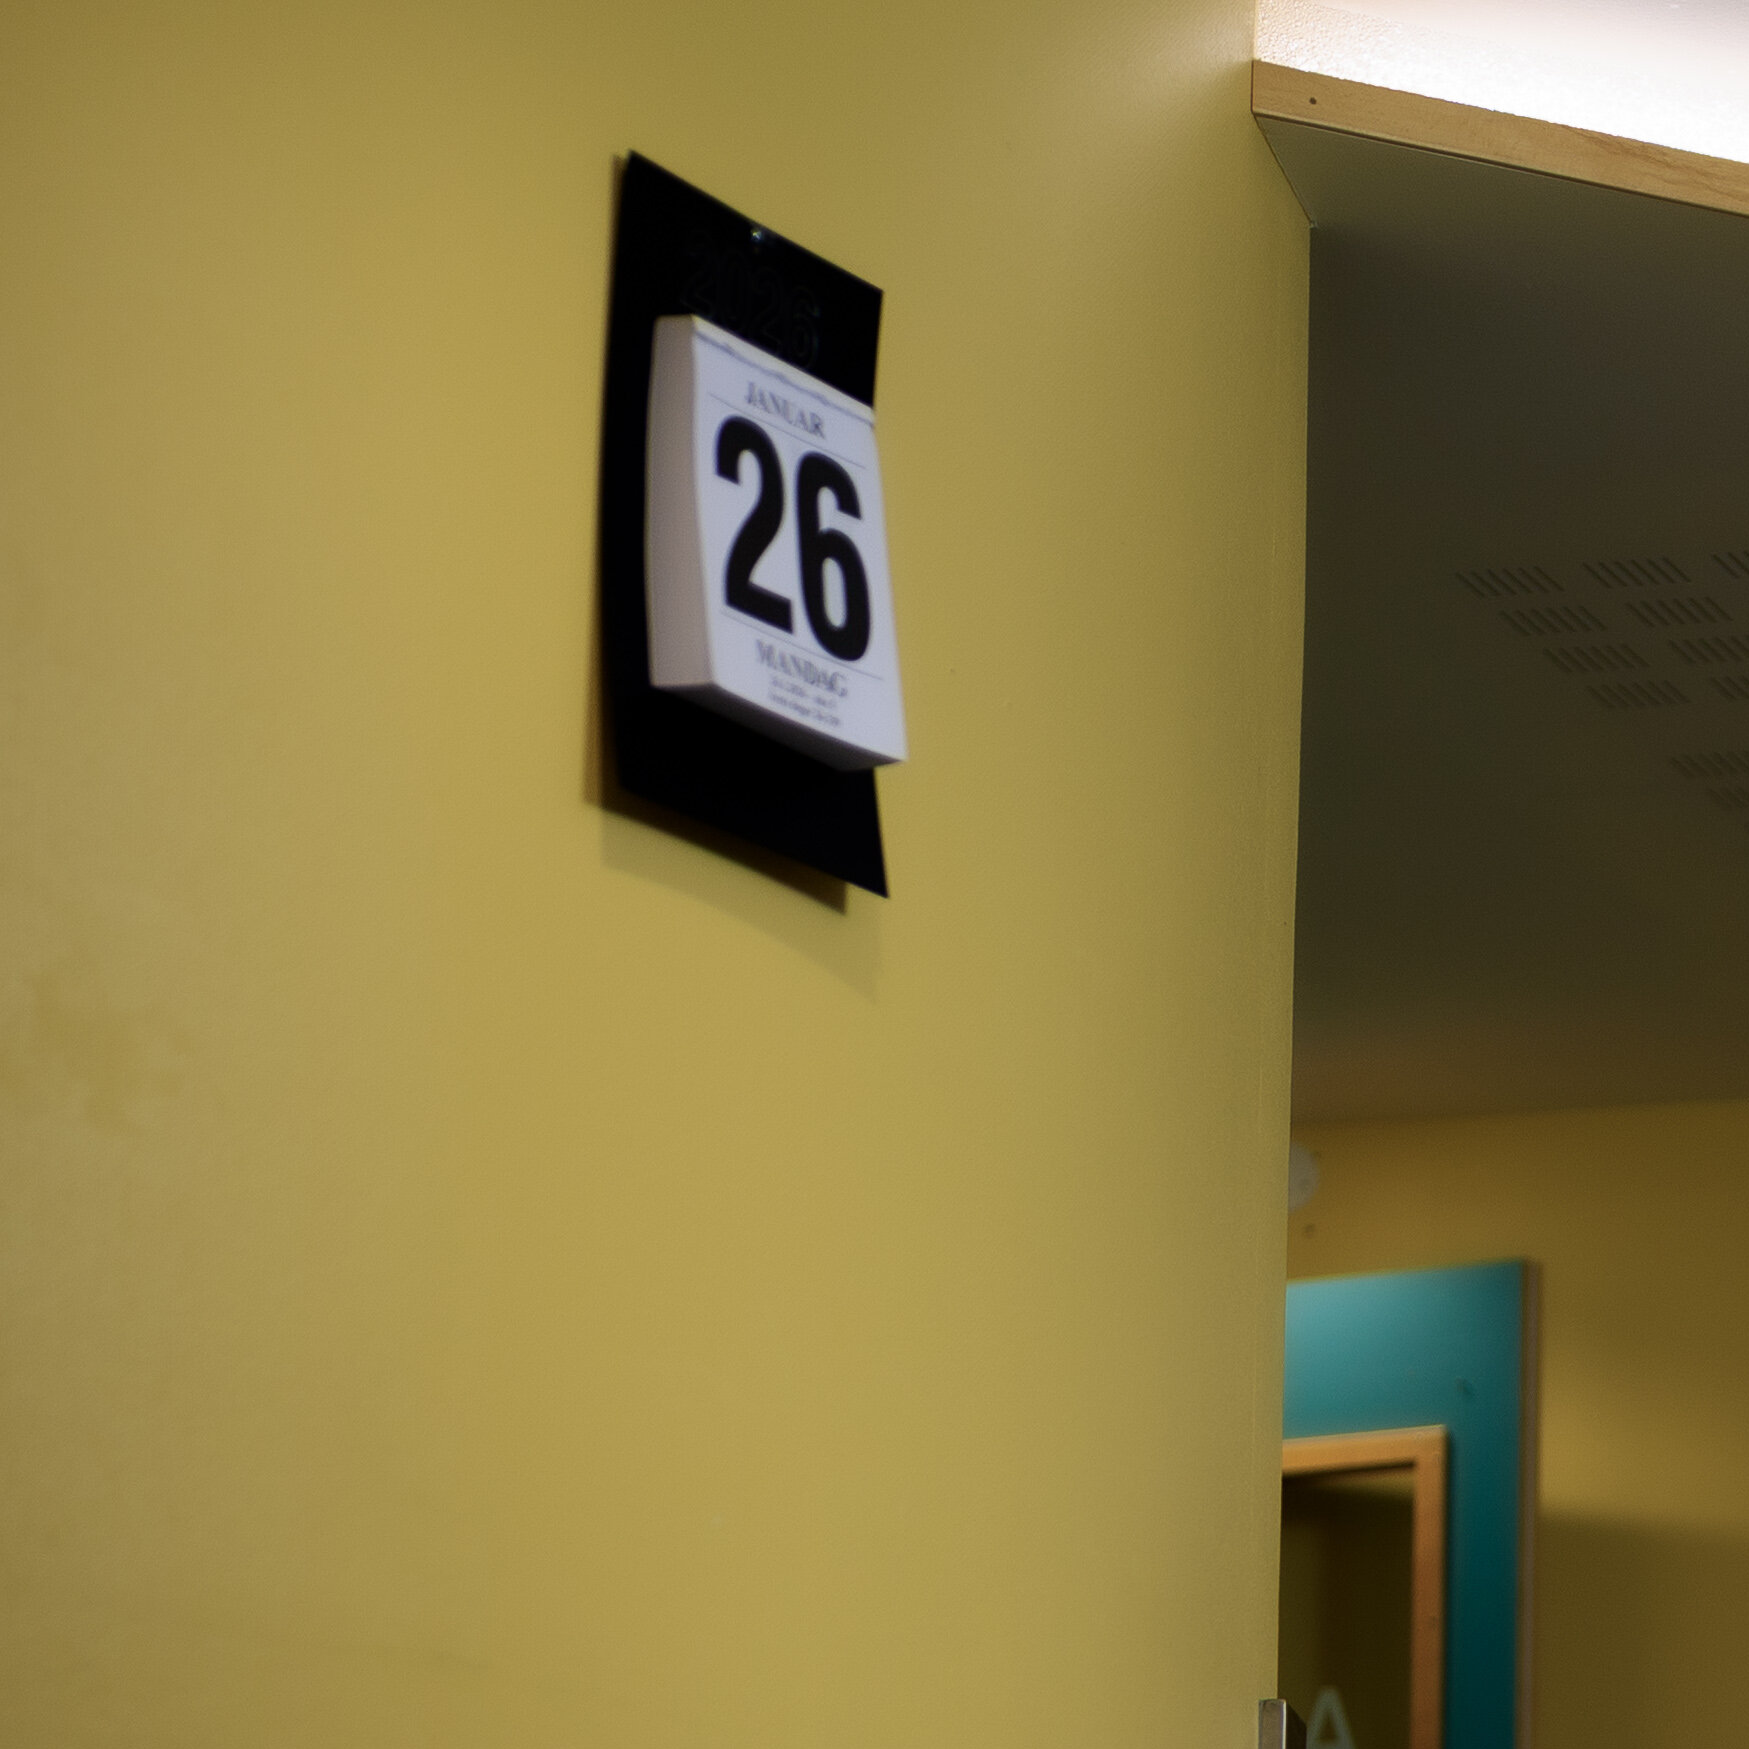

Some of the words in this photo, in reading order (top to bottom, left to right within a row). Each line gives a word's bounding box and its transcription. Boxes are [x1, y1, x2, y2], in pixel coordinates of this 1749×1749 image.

[680, 229, 819, 368] 2026
[745, 381, 827, 439] JANUAR
[714, 415, 871, 661] 26
[756, 639, 848, 699] MANDAG
